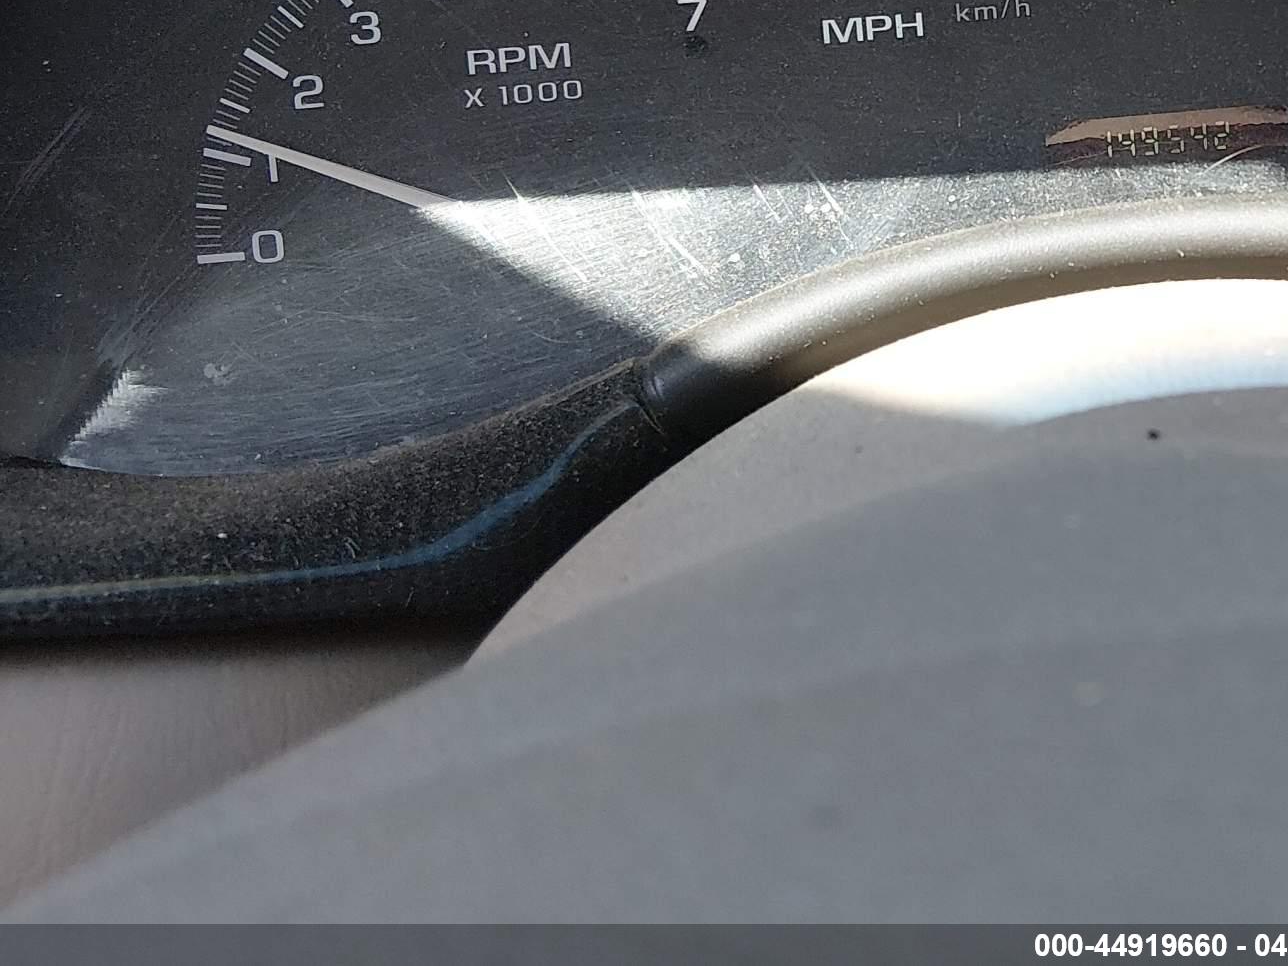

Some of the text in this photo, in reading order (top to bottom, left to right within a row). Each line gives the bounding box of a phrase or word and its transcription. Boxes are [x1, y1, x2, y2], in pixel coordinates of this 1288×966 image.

[350, 12, 381, 44] 3
[823, 13, 923, 43] MPH
[467, 43, 570, 74] RPM
[293, 75, 324, 109] 2
[499, 81, 581, 104] 1000
[1107, 120, 1230, 158] 149542
[252, 230, 284, 263] 0
